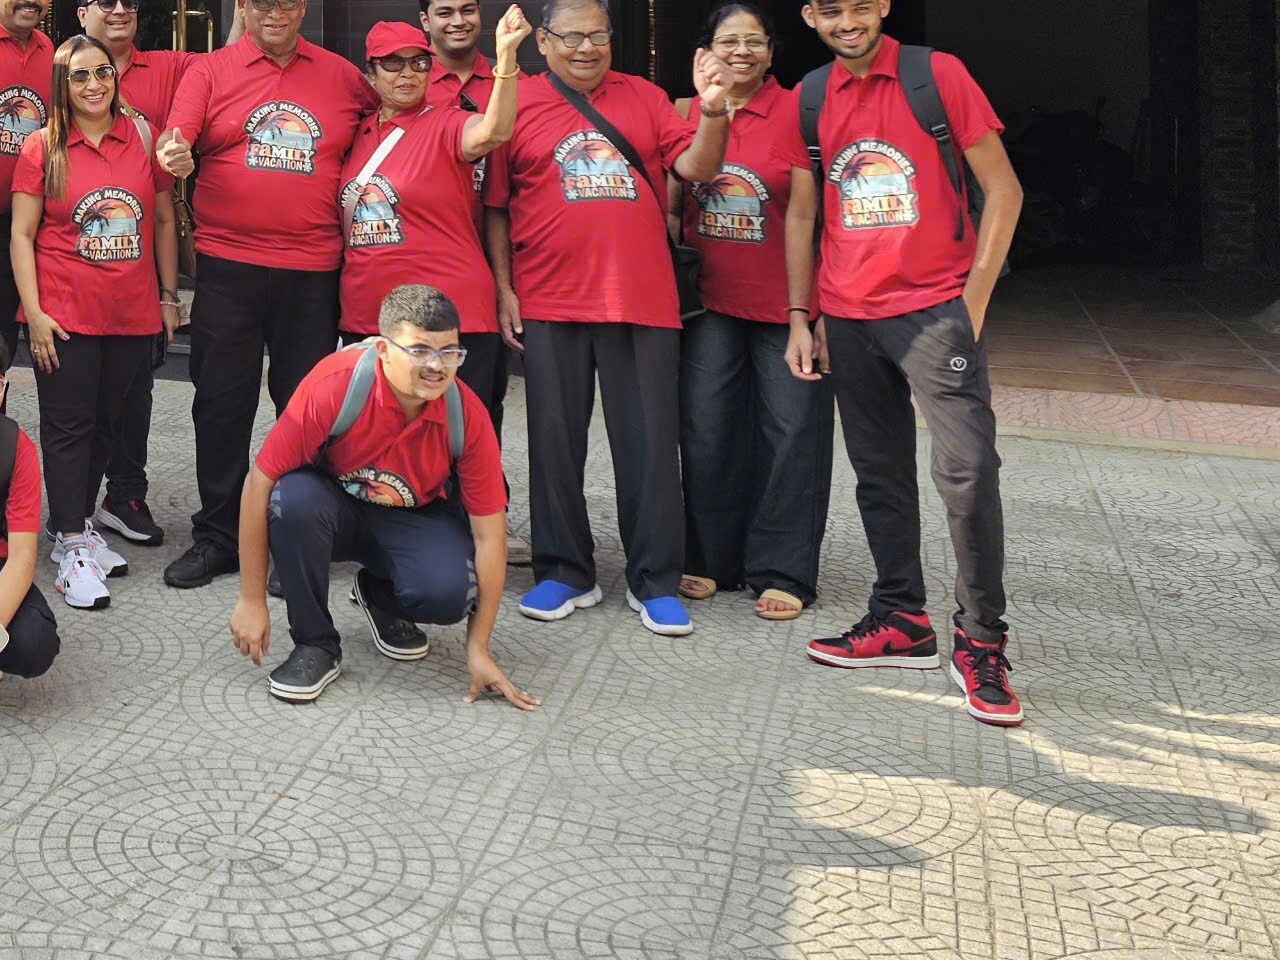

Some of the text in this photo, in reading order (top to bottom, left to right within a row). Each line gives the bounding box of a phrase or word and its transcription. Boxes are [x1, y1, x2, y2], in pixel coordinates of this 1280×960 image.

[245, 103, 321, 138] MAKING MEMORIES
[257, 156, 304, 171] VACATION
[554, 132, 586, 163] MAKING
[829, 141, 915, 181] MAKING MEMORIES
[578, 187, 627, 198] VACATION
[722, 164, 770, 202] MEMORIES
[73, 189, 143, 223] MAKING MEMORIES
[89, 248, 132, 260] VACATION
